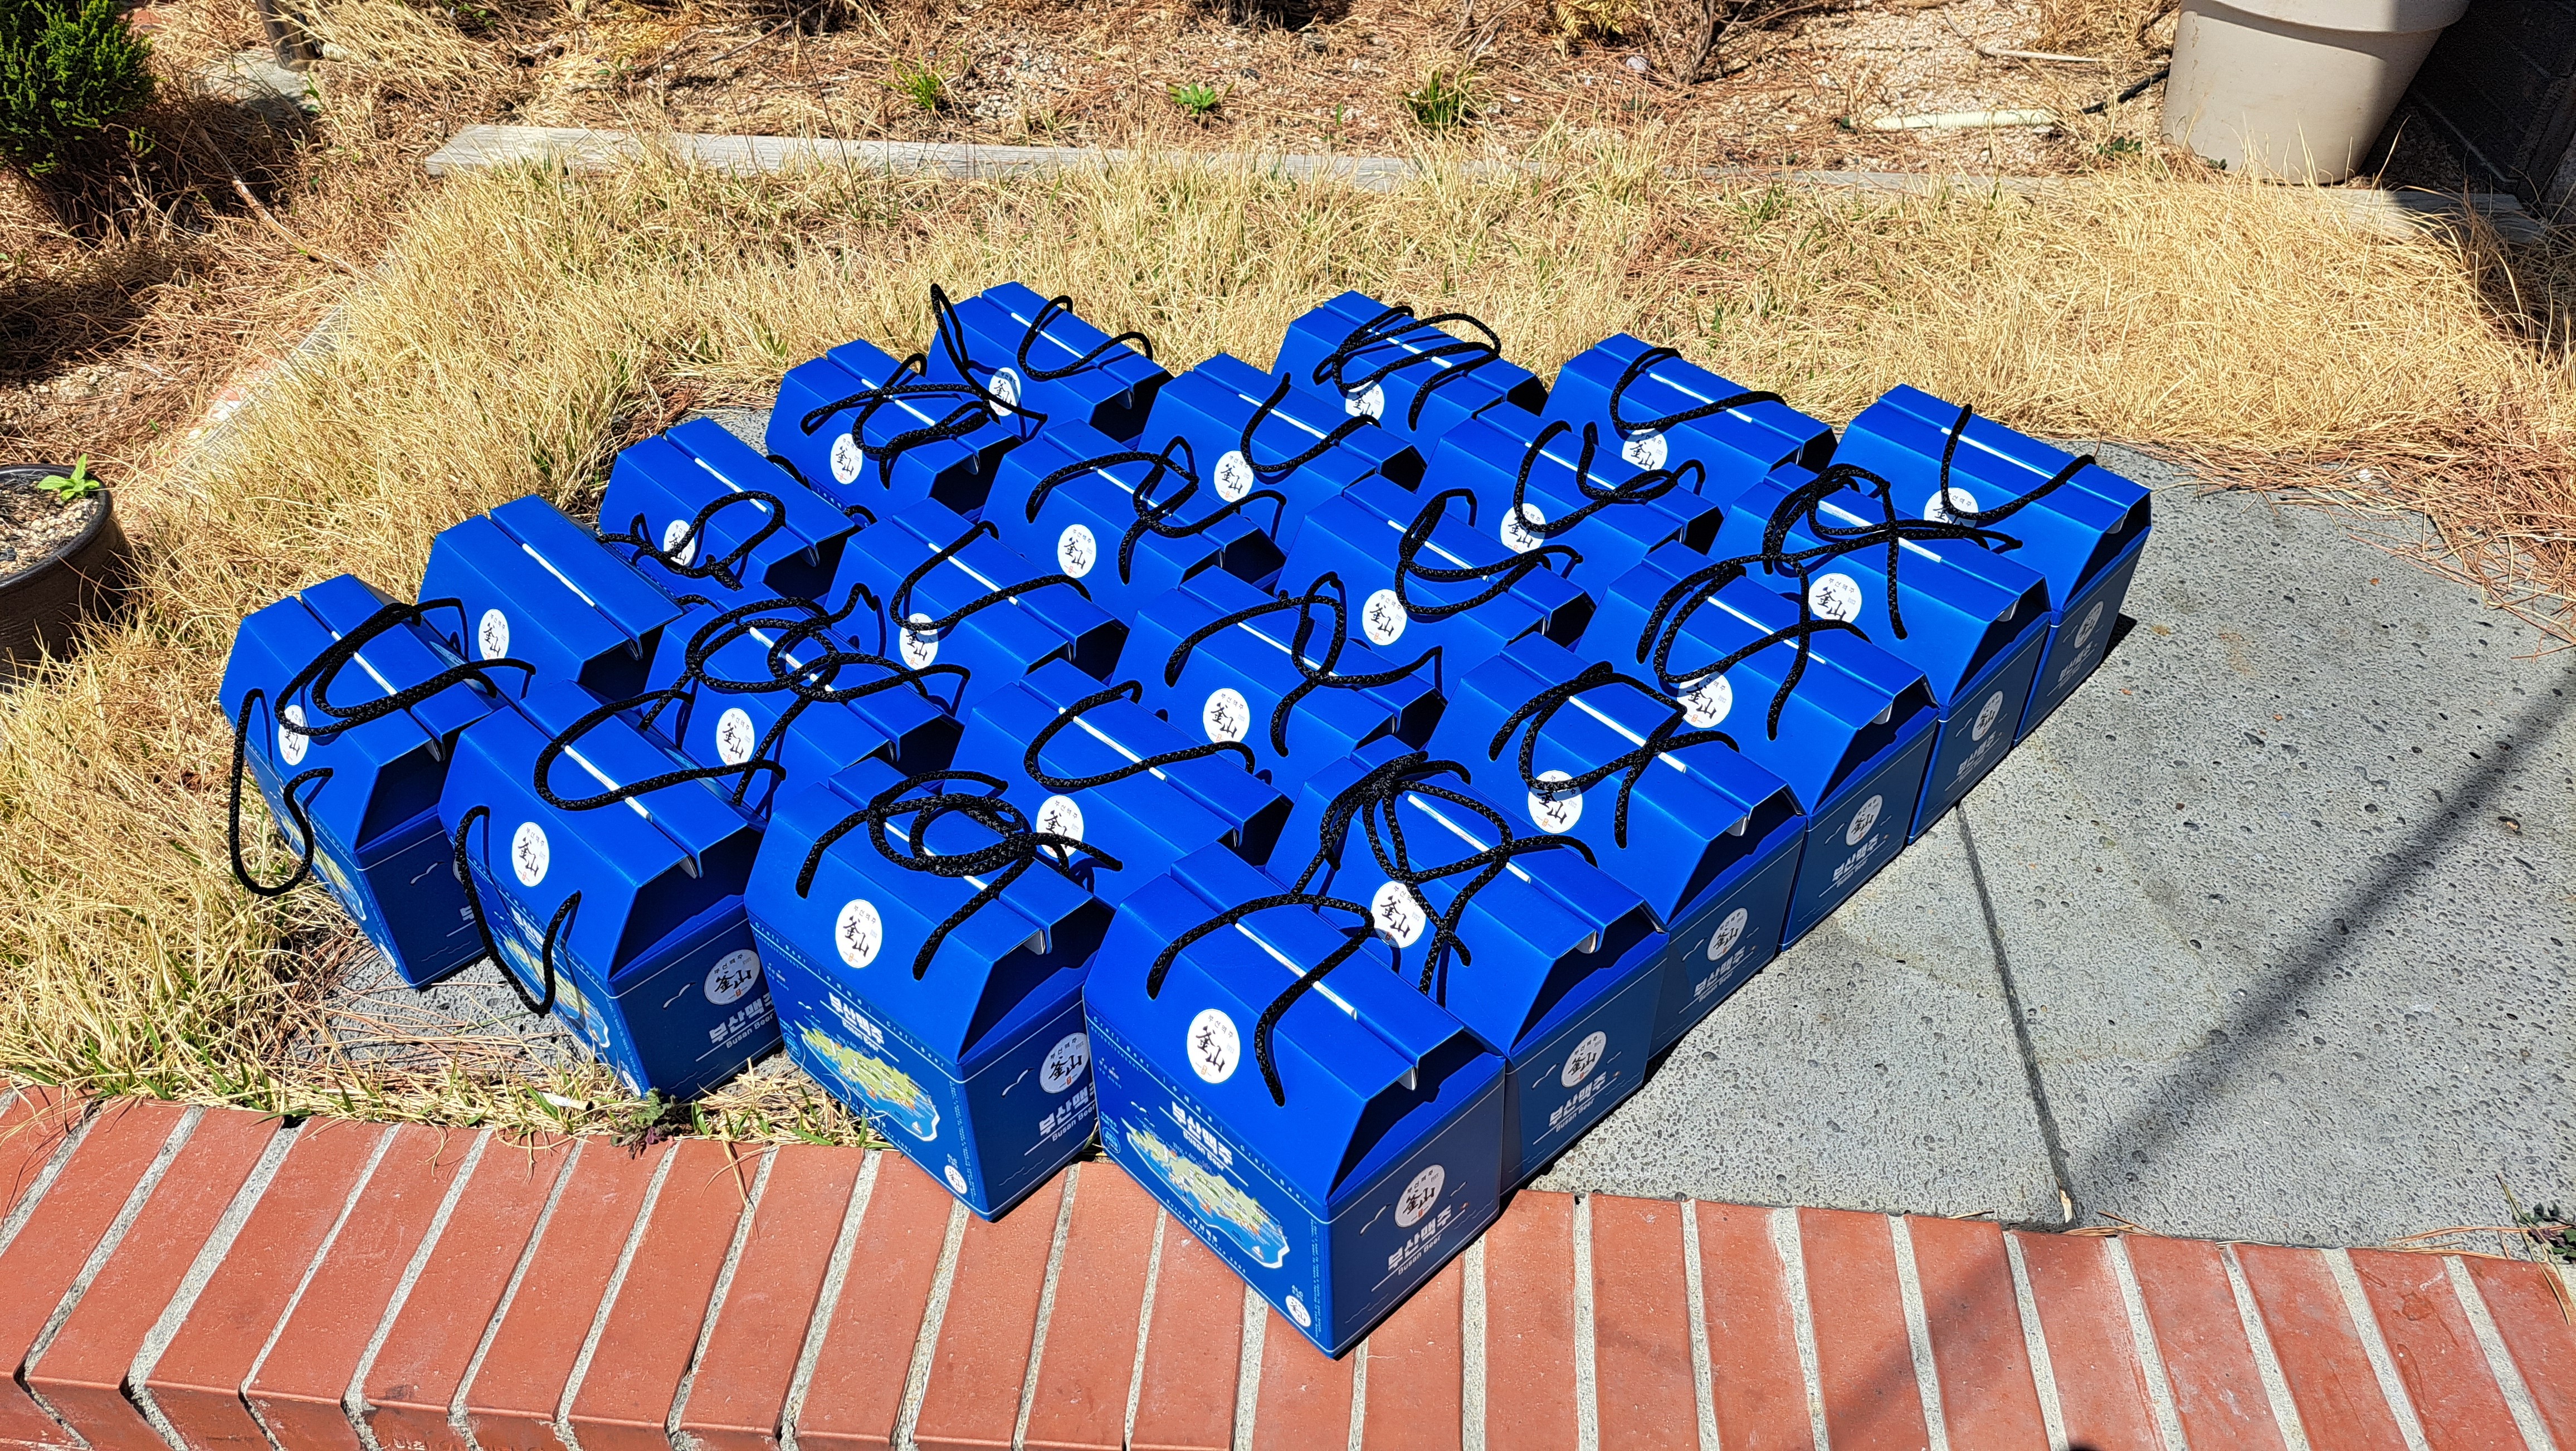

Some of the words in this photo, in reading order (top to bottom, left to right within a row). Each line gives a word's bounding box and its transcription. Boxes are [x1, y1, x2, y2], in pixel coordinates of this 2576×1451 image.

[1524, 510, 1540, 522] 산맥주
[726, 1026, 753, 1049] Busan
[754, 1014, 773, 1031] Beer
[828, 991, 885, 1044] 부산맥주
[1549, 1071, 1607, 1128] 부산맥주
[1052, 1119, 1076, 1142] Busan
[1172, 1101, 1233, 1166] 부산맥주
[1183, 1130, 1206, 1155] Busan
[1207, 1151, 1224, 1171] Beer
[1388, 1204, 1452, 1271] 부산맥주
[1398, 1253, 1422, 1275] Busan
[1423, 1234, 1442, 1254] Beer
